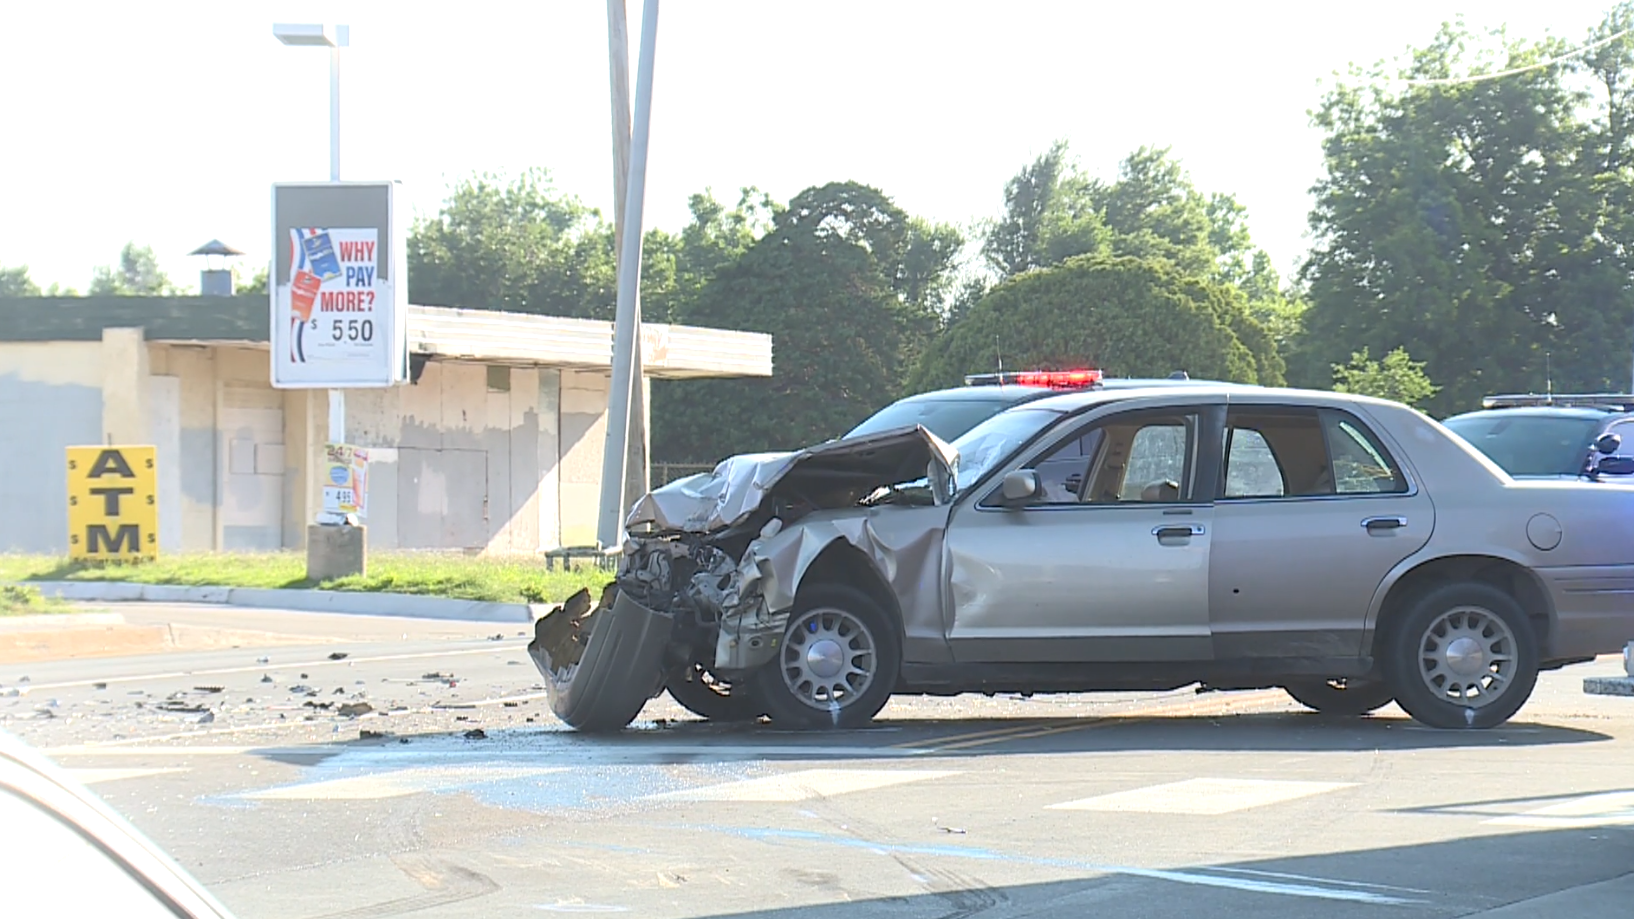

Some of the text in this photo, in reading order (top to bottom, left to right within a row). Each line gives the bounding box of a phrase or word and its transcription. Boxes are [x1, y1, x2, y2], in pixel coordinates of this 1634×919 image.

[339, 241, 375, 262] WHY
[346, 266, 375, 287] PAY
[320, 291, 375, 312] MORE?
[86, 449, 140, 553] ATM
